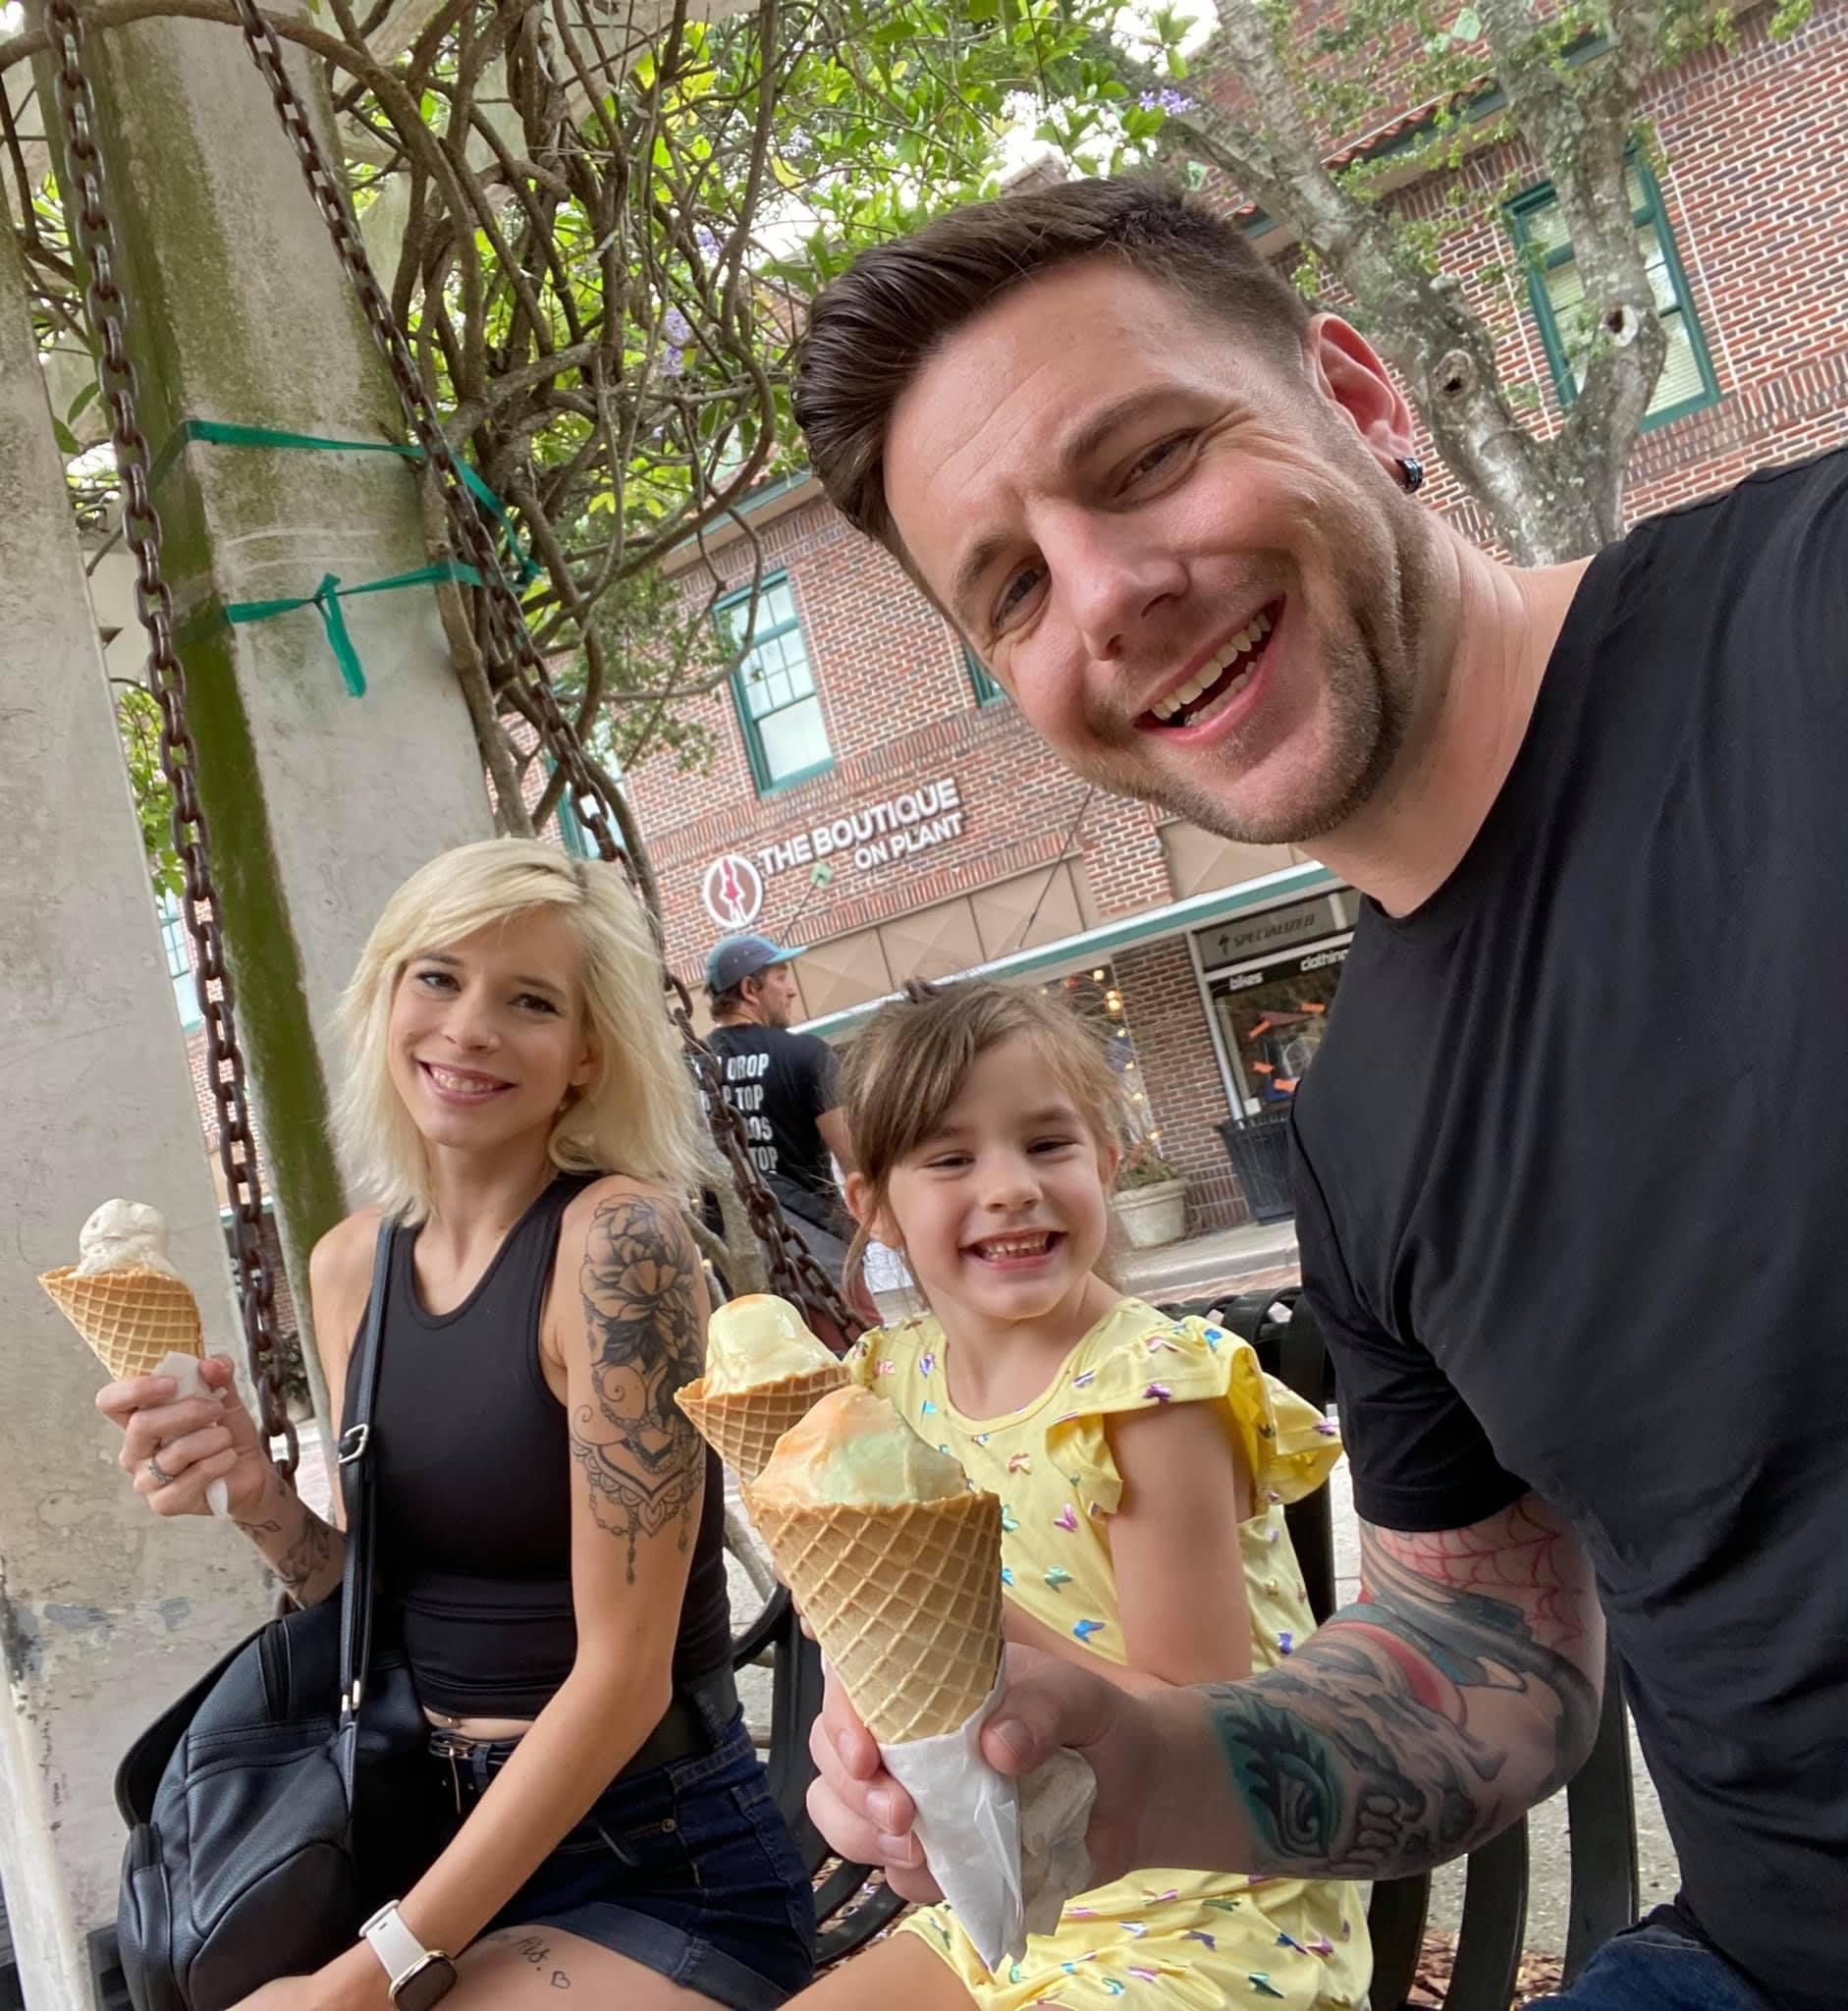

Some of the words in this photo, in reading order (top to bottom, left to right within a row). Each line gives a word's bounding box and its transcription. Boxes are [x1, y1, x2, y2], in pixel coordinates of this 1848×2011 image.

[758, 835, 813, 874] THE
[813, 778, 959, 855] BOUTIQUE
[855, 842, 890, 870] ON
[892, 813, 962, 857] PLANT
[1229, 972, 1265, 991] bikes
[727, 1053, 770, 1081] DROP
[734, 1084, 764, 1111] TOP
